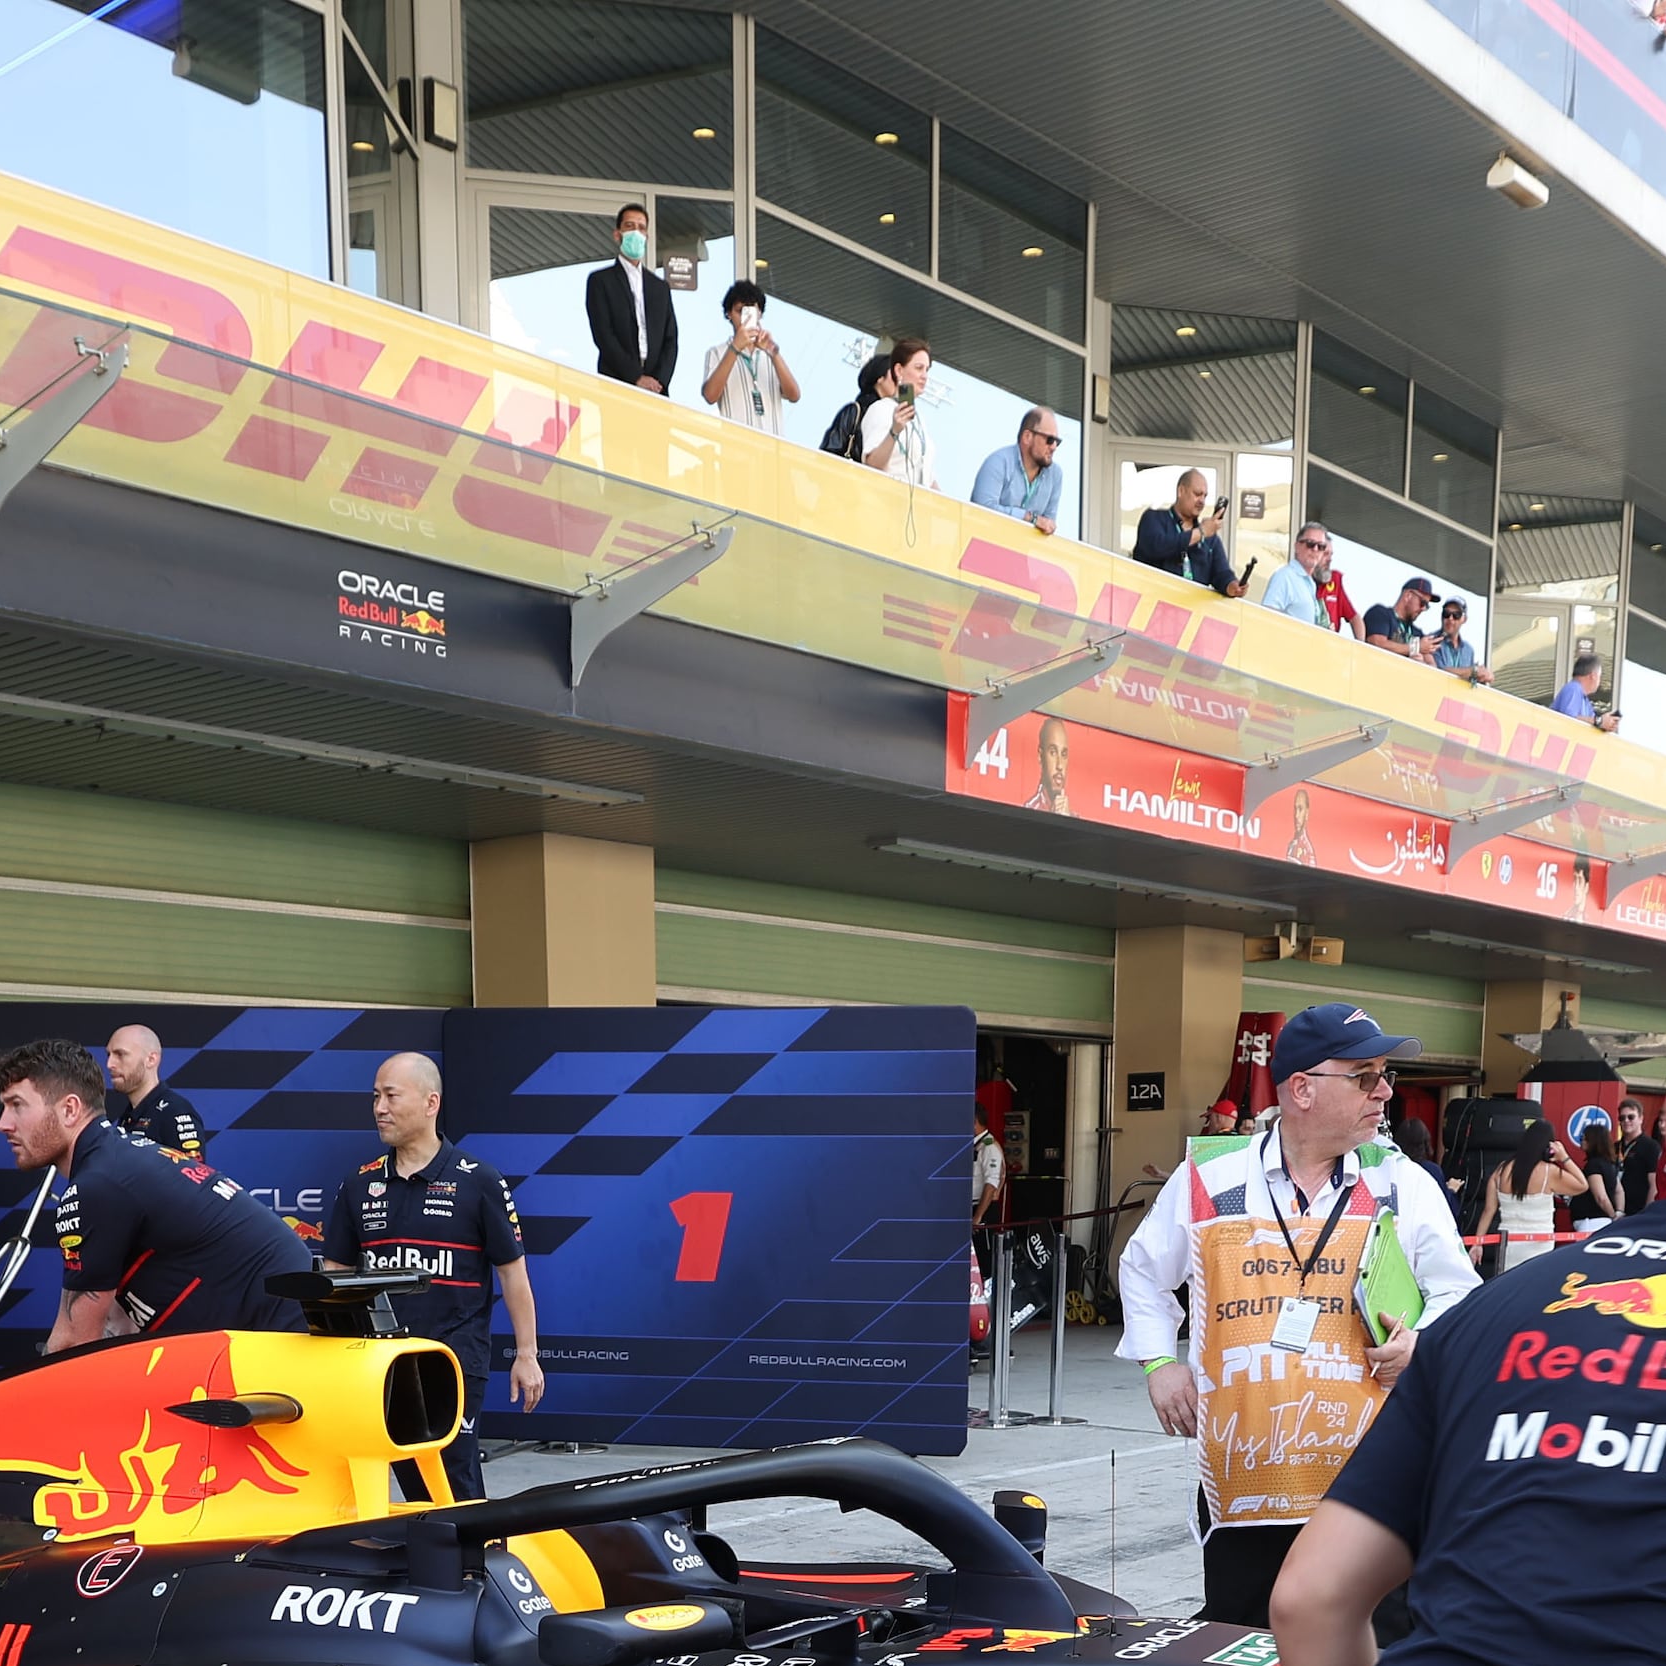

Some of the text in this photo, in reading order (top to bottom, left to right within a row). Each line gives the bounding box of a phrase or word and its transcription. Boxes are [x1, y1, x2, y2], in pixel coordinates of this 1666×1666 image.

[338, 571, 445, 613] ORACLE
[339, 625, 447, 659] RACING
[949, 537, 1250, 731] DHL
[974, 728, 1009, 779] 44
[1171, 758, 1201, 800] Lewis
[1104, 785, 1260, 839] HAMILTON
[1349, 817, 1447, 874] هاميلتون
[1536, 862, 1558, 898] 16
[1130, 1084, 1162, 1100] 12A
[175, 1115, 191, 1123] VISA
[179, 1131, 197, 1140] ROKT
[249, 1188, 323, 1212] CLE
[55, 1217, 80, 1233] ROKT
[668, 1192, 733, 1282] 1
[405, 1248, 453, 1277] Bull
[1030, 1232, 1050, 1265] aws
[749, 1354, 906, 1369] REDBULLRACING.COM
[1222, 1343, 1296, 1388] PIT
[1301, 1342, 1350, 1360] ALL
[1496, 1330, 1641, 1389] Red
[1301, 1361, 1364, 1383] TIME
[1327, 1416, 1345, 1428] 24
[673, 1553, 704, 1573] Gate
[270, 1585, 420, 1634] ROKT
[519, 1595, 551, 1615] Gate
[1115, 1617, 1209, 1660] ORACLE
